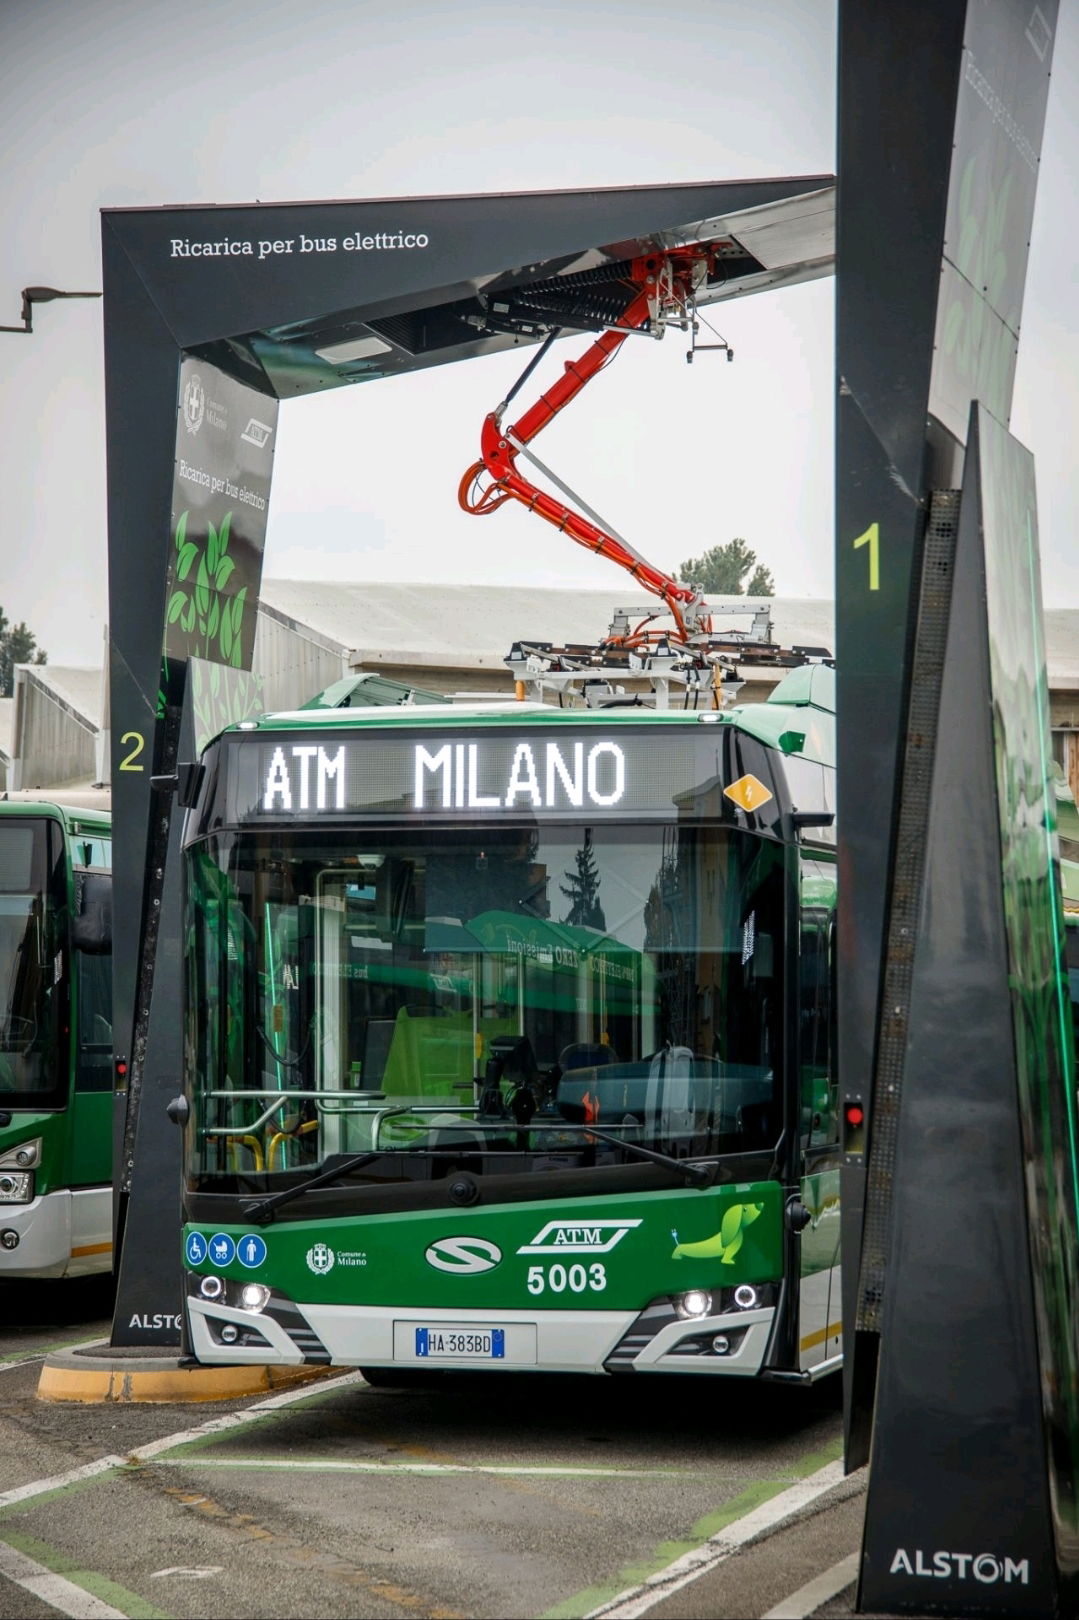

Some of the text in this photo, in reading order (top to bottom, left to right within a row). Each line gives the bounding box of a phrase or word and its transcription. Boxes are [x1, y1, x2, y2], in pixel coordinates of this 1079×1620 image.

[170, 230, 429, 259] Ricarica per bus elettrico
[179, 459, 266, 511] Ricarica per bus elettrico
[853, 522, 880, 591] 1
[119, 731, 145, 772] 2
[263, 741, 626, 810] ATM MILANO
[552, 1228, 602, 1245] ATM
[337, 1257, 367, 1266] Milano
[527, 1263, 607, 1295] 5003
[889, 1548, 1029, 1585] ALSTOM
